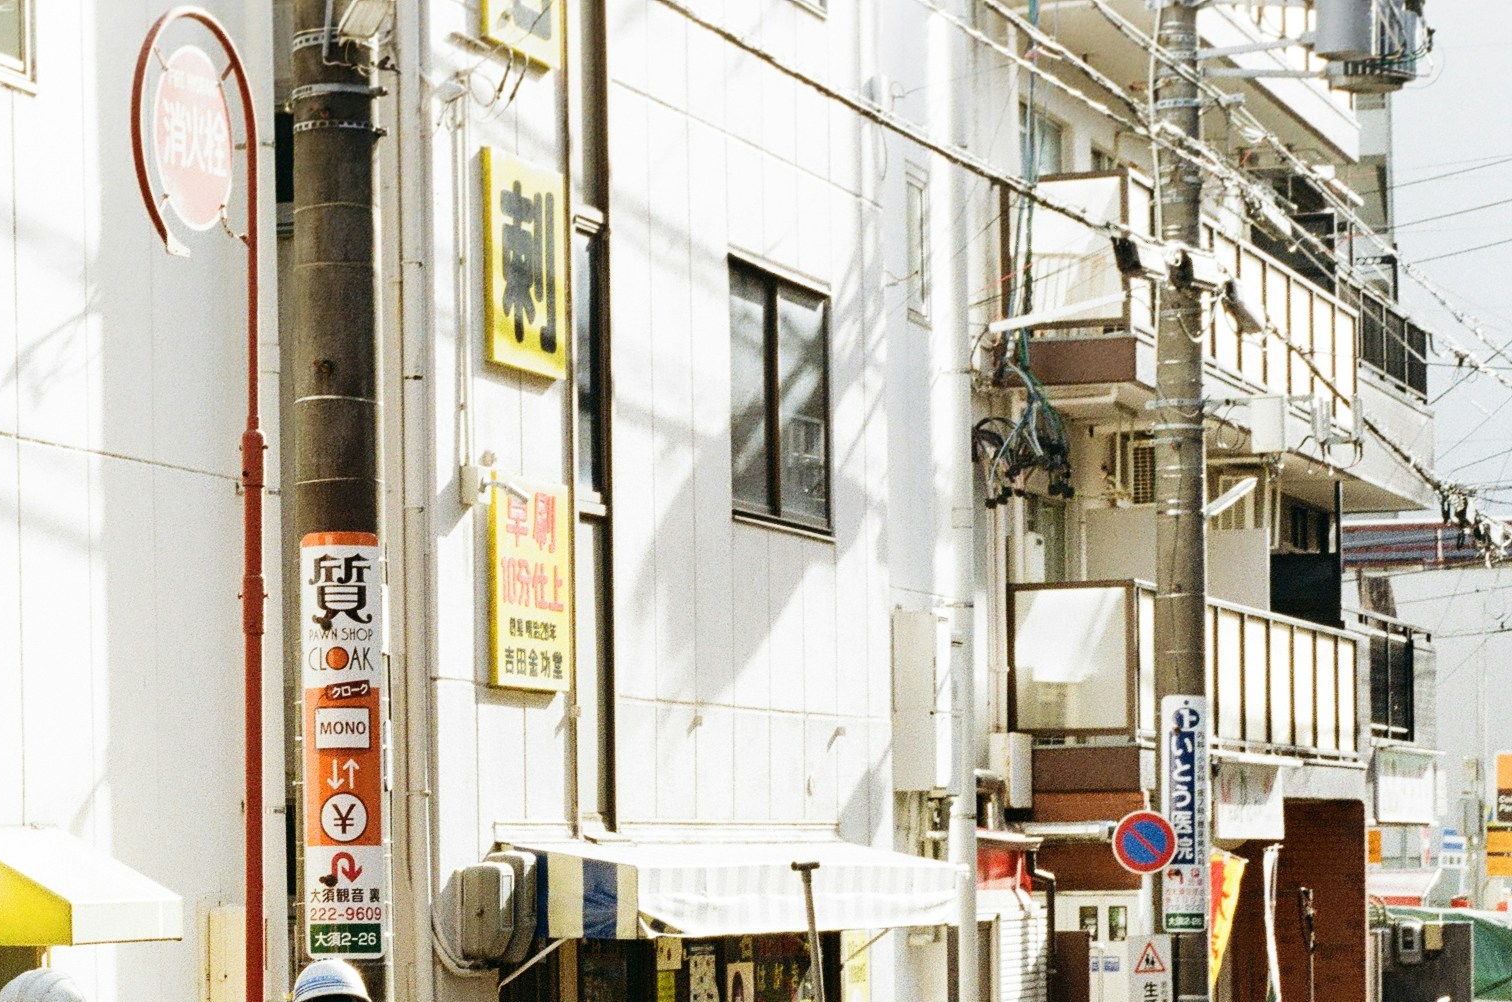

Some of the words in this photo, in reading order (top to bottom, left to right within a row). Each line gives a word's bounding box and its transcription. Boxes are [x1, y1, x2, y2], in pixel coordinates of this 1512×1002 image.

[308, 553, 372, 624] 質
[309, 628, 337, 642] PAWN
[341, 627, 374, 641] SHOP
[308, 646, 374, 672] CLOAK
[331, 683, 369, 699] クローク
[320, 721, 367, 735] MONO
[311, 888, 364, 903] 大須観音
[310, 906, 382, 921] 222-9609
[314, 932, 377, 947] 大須2-26
